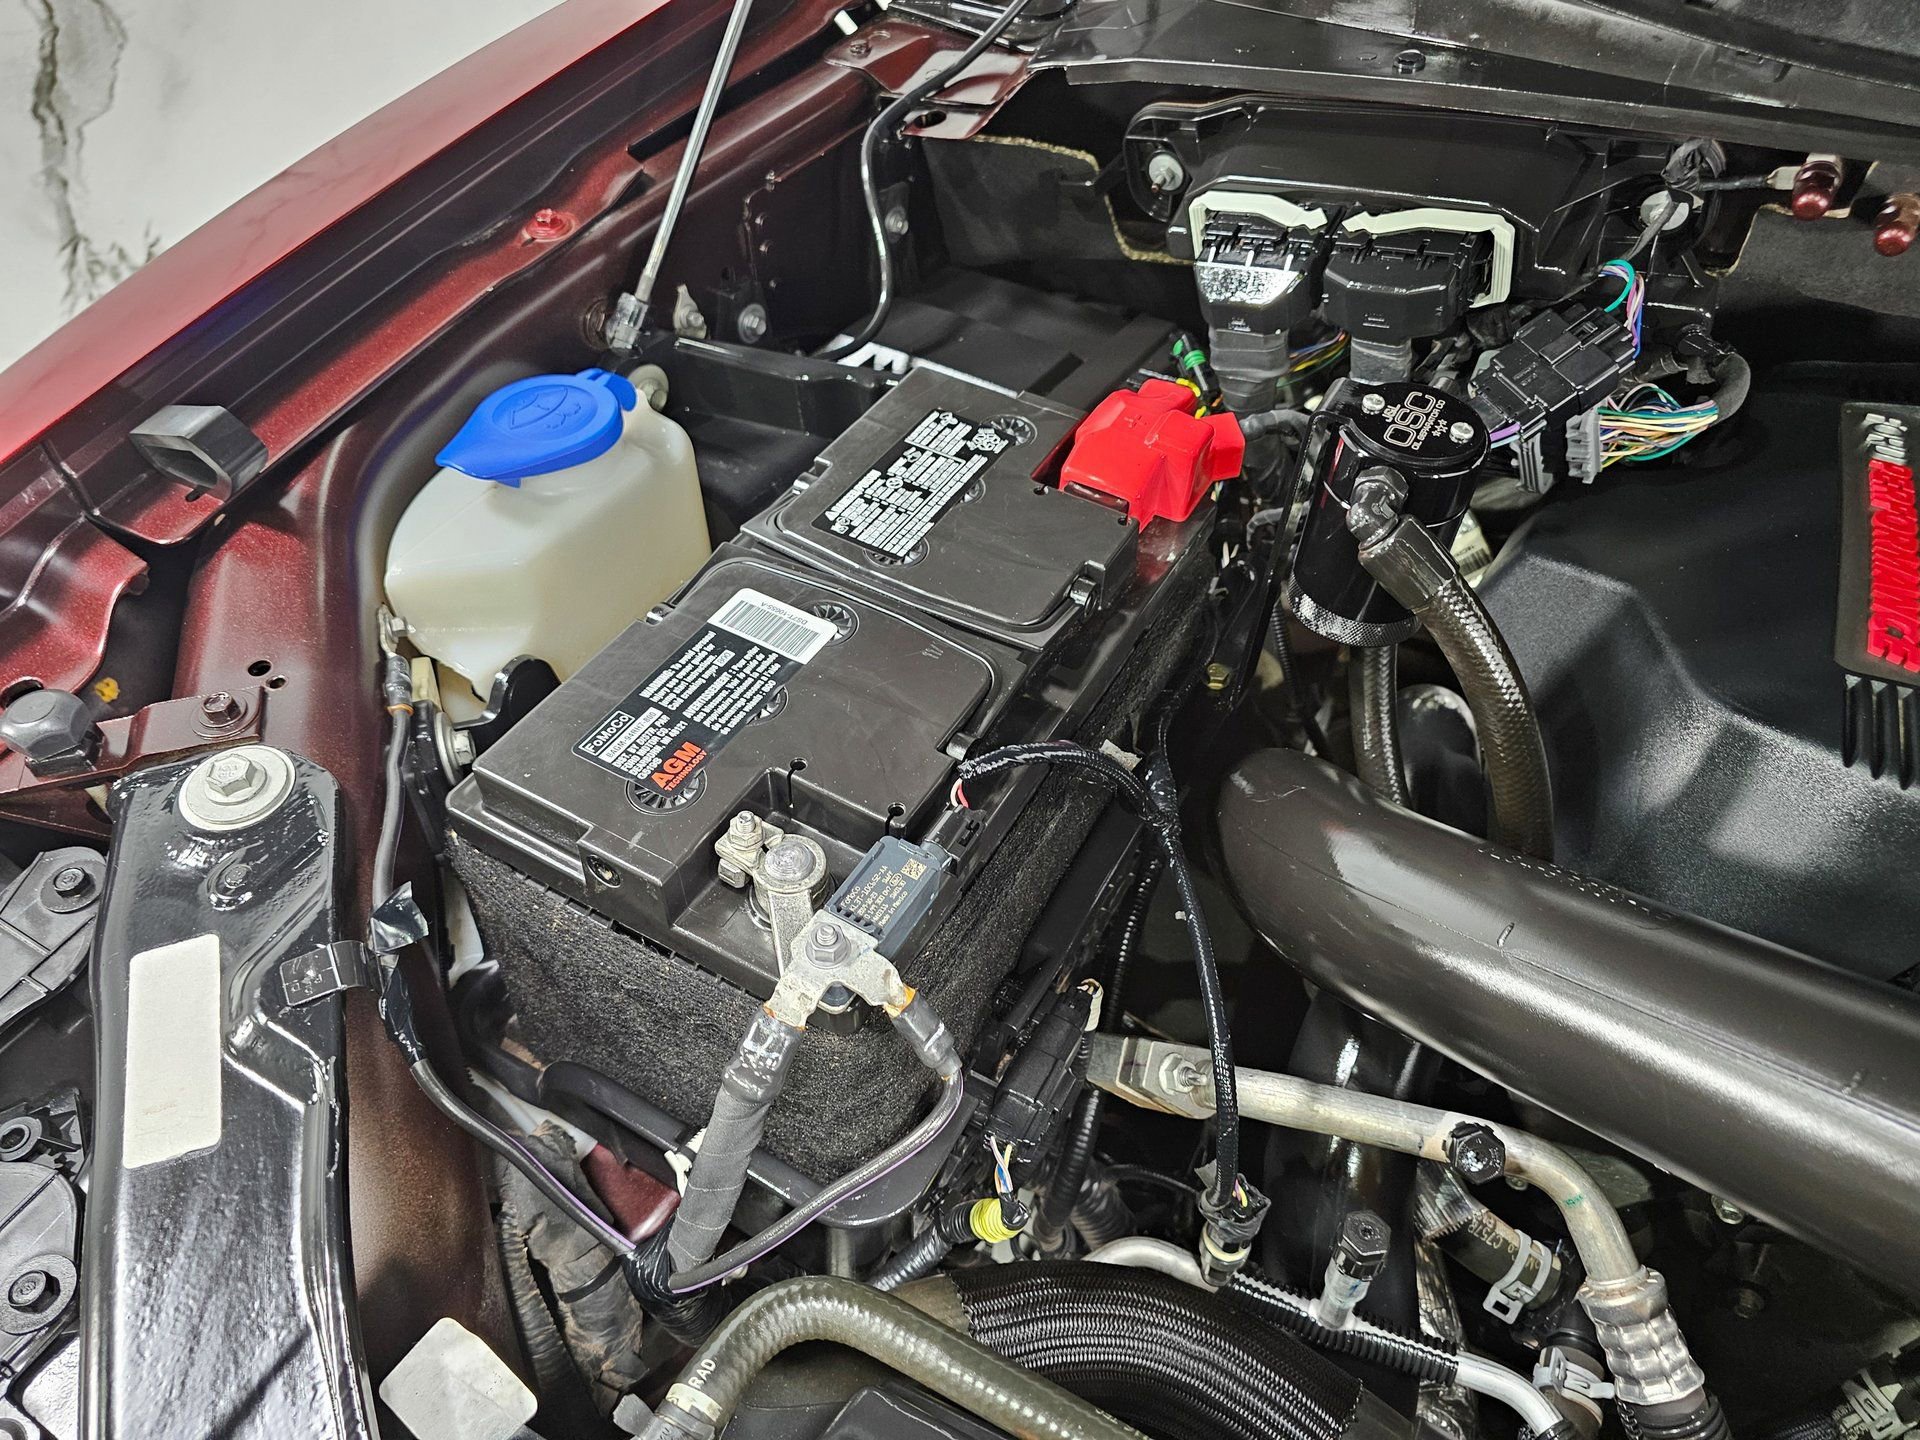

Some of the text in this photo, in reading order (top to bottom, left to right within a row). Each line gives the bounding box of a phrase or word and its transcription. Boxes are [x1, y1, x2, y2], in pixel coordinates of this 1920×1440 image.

[1383, 391, 1437, 448] OSC
[1411, 441, 1423, 451] OIL
[1417, 409, 1441, 441] SEPARATOR
[1867, 458, 1920, 673] PERFORMANCE
[584, 713, 631, 753] FoMoCo
[626, 743, 639, 754] BY
[620, 755, 641, 772] FORD
[636, 735, 661, 756] MOTOR
[651, 741, 701, 789] AGM
[664, 750, 707, 791] TECHNOLOGY
[840, 886, 861, 908] FoMoCo
[688, 1359, 716, 1390] RAD
